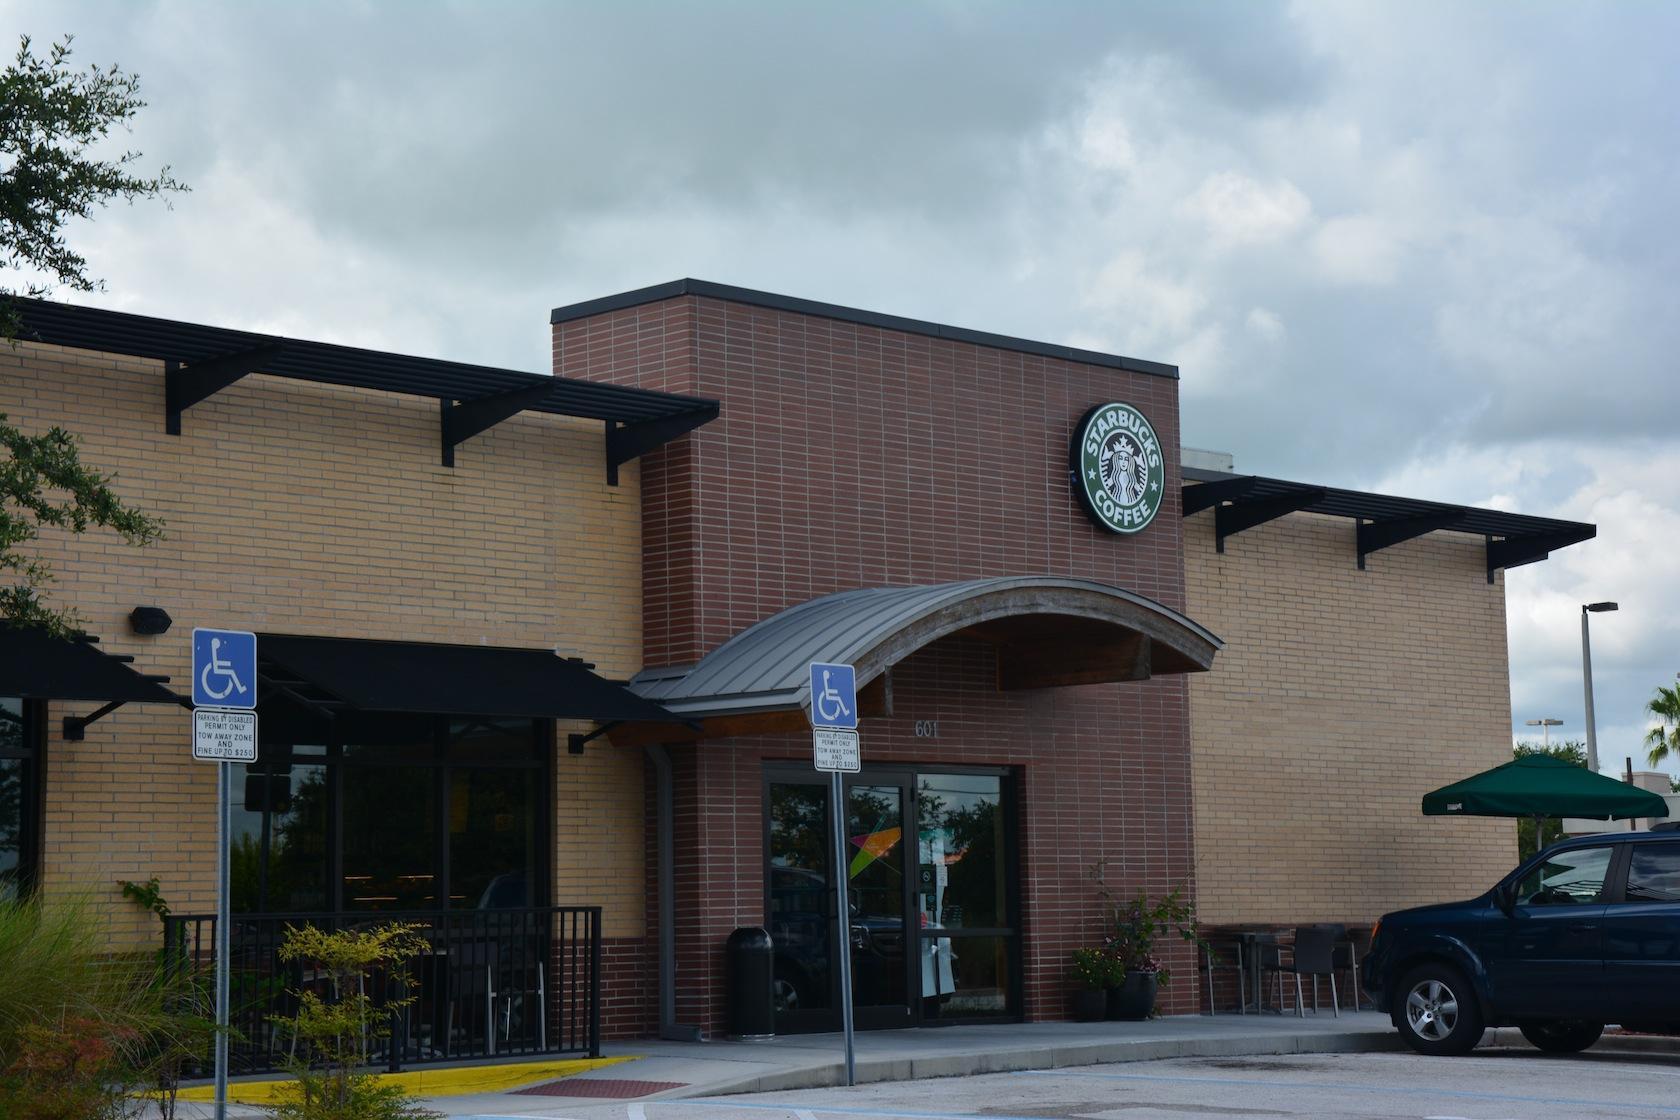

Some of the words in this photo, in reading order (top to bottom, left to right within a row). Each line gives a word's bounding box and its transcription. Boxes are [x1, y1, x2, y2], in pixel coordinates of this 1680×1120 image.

[1087, 410, 1159, 468] STARBUCKS
[1095, 490, 1151, 526] COFFEE
[197, 714, 219, 722] PARKING
[228, 716, 253, 724] DISABLED
[205, 722, 227, 730] PERMIT
[229, 723, 245, 731] ONLY
[915, 719, 937, 738] 601
[198, 732, 212, 740] TOW
[234, 734, 253, 742] ZONE
[218, 740, 233, 748] AND
[197, 747, 212, 755] FINE
[224, 748, 233, 756] TO
